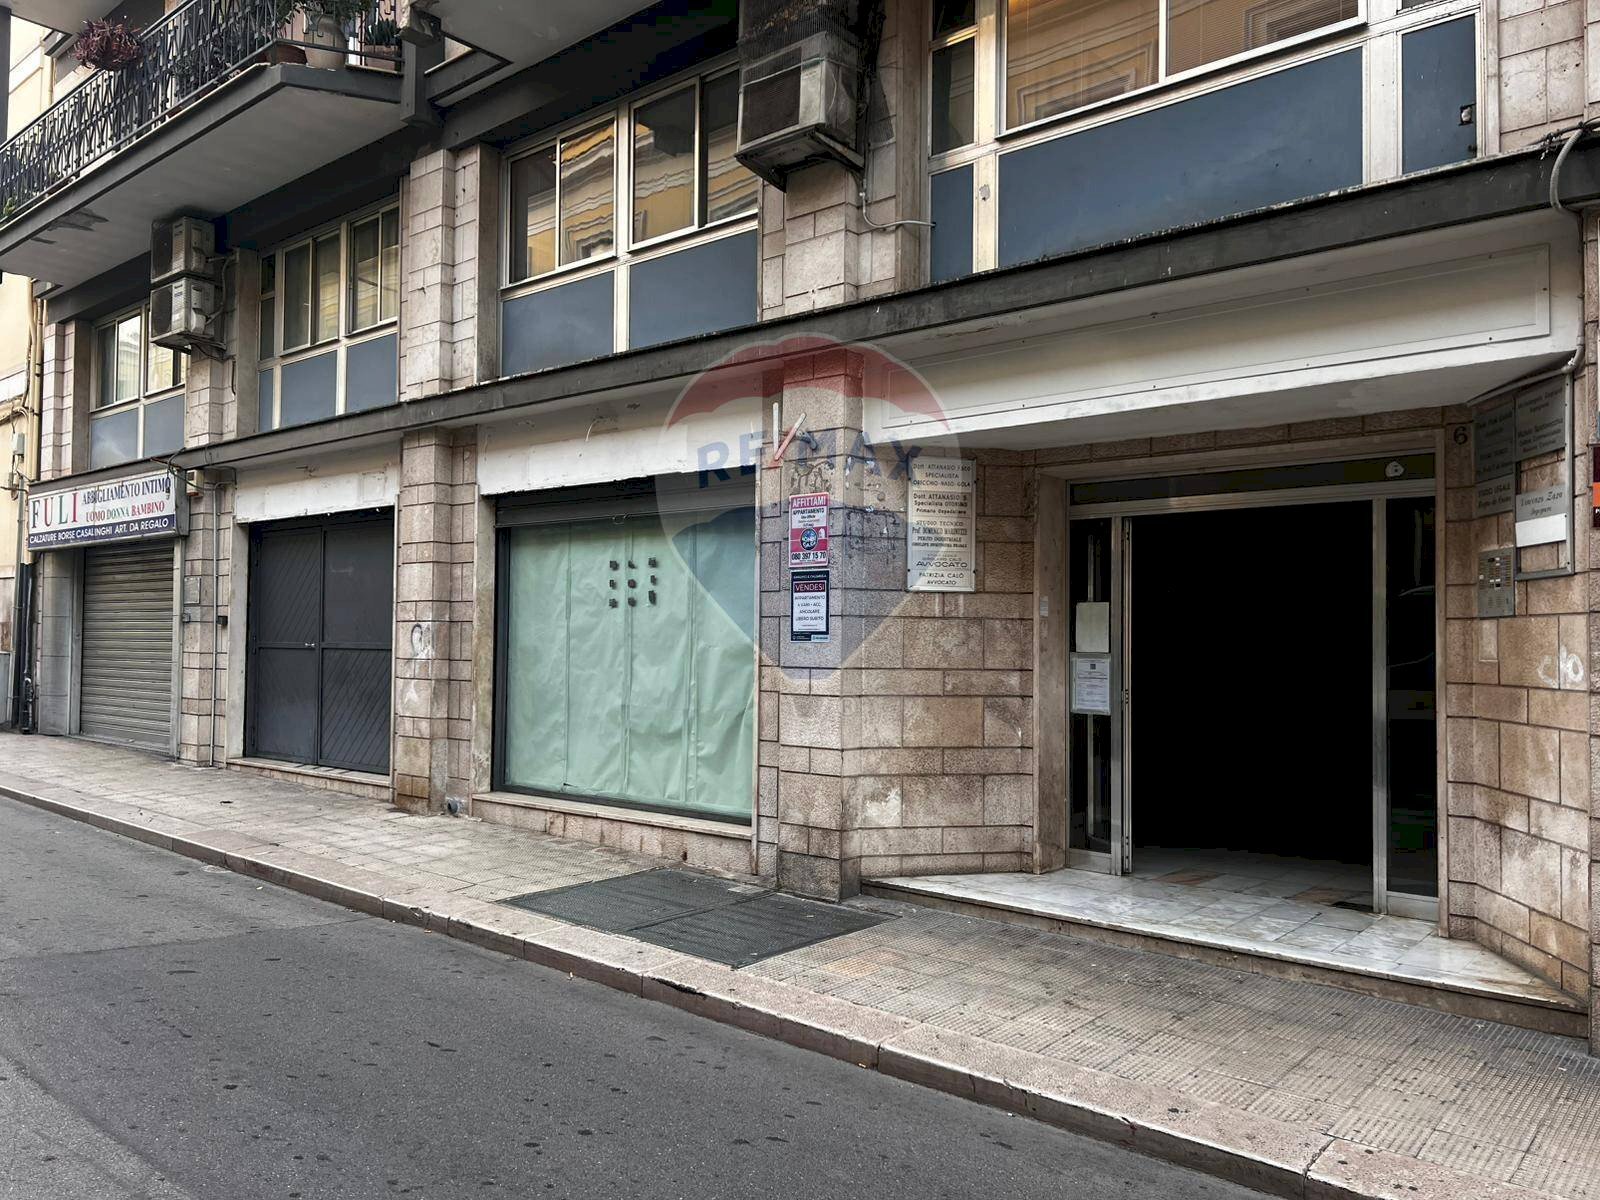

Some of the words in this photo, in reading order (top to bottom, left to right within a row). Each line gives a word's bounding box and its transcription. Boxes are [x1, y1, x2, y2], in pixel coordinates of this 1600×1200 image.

[1453, 426, 1468, 445] 6
[82, 482, 141, 505] ABBIGLIAMENTO
[141, 477, 171, 495] INTIMO
[31, 492, 79, 529] FULI
[86, 510, 105, 522] UOMO
[105, 506, 130, 520] DONNA
[131, 500, 165, 517] BAMBINO
[792, 497, 826, 508] AFFITTAMI
[29, 532, 57, 544] CALZATURE
[57, 530, 76, 541] BORSE
[75, 526, 113, 538] CASALINGHI
[114, 524, 128, 534] ART.
[129, 522, 139, 532] DA
[140, 518, 169, 530] REGALO
[791, 553, 801, 561] 080
[802, 552, 811, 560] 397
[794, 583, 825, 592] VENDESI
